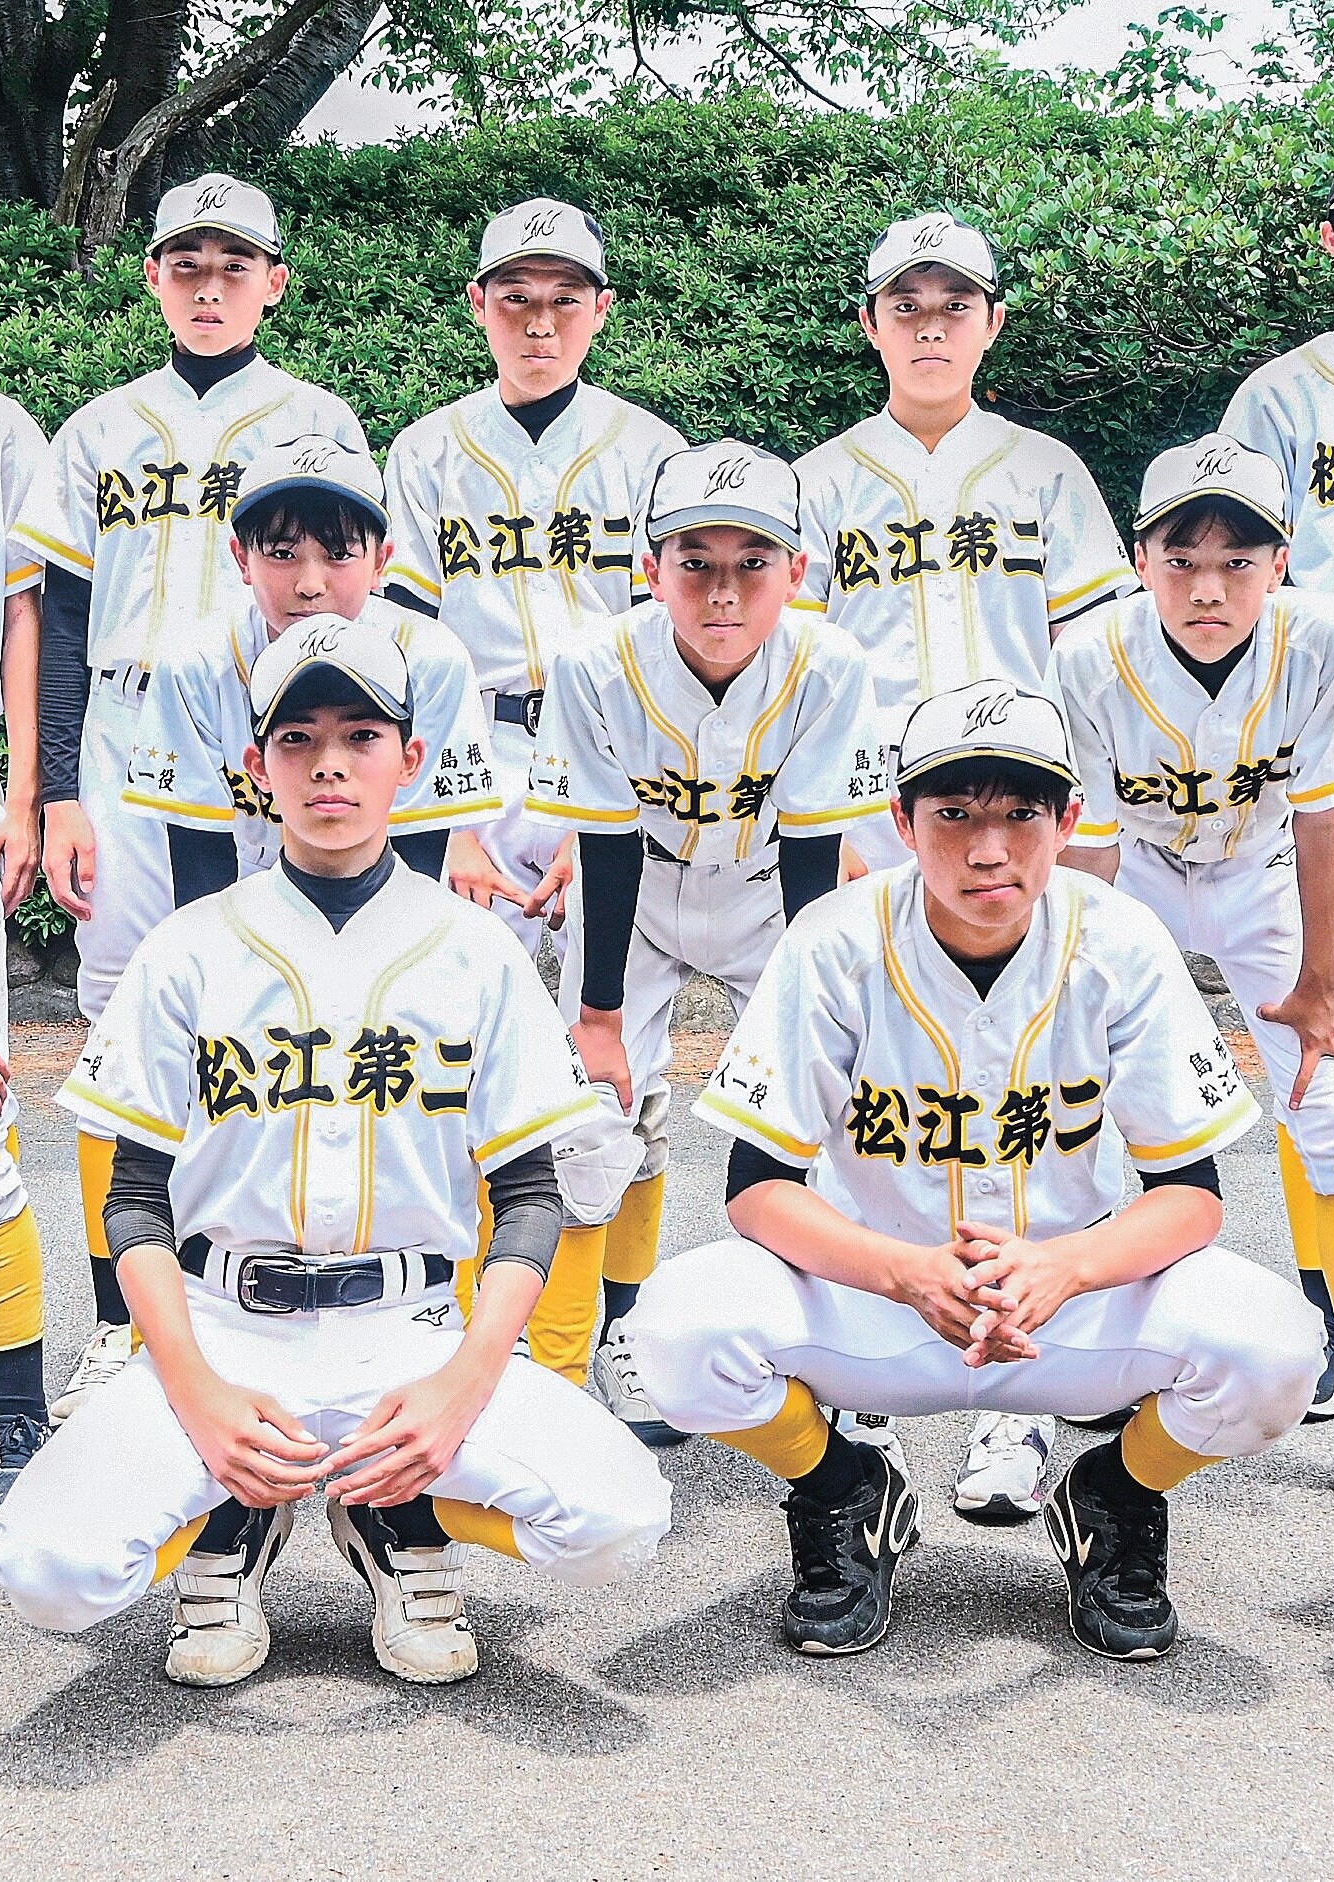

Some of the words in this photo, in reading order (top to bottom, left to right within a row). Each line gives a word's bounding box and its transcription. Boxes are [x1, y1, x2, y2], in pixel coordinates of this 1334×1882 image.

[97, 460, 247, 533] 松江第
[438, 508, 633, 581] 松江第二
[834, 511, 1045, 592] 松江第二
[433, 768, 492, 798] 松江市
[440, 743, 485, 770] 島根
[197, 1026, 471, 1122] 松江第二
[715, 1062, 767, 1110] 人一役
[846, 1077, 1103, 1166] 松江第二
